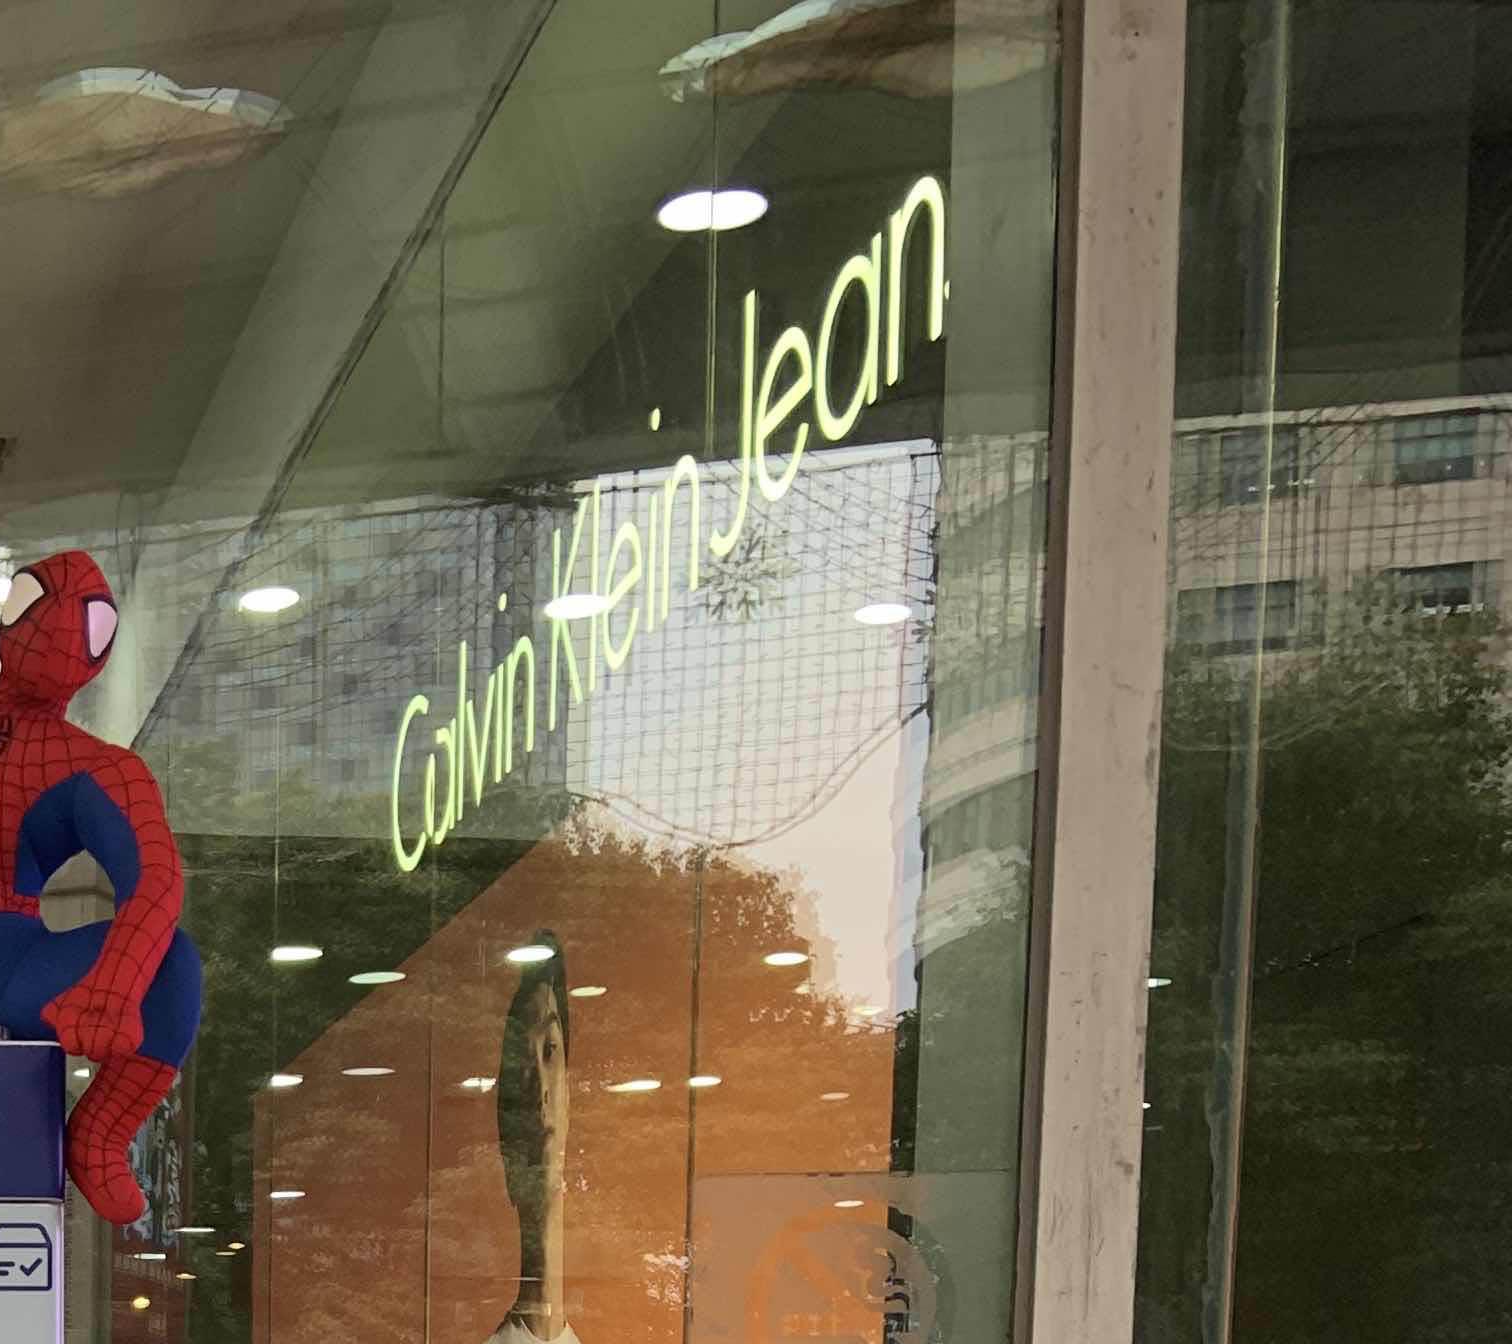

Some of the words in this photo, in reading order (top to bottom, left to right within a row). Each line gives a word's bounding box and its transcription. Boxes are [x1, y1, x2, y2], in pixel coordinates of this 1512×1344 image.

[392, 592, 535, 872] Calvin
[548, 406, 700, 733] Klein
[709, 175, 950, 556] Jean
